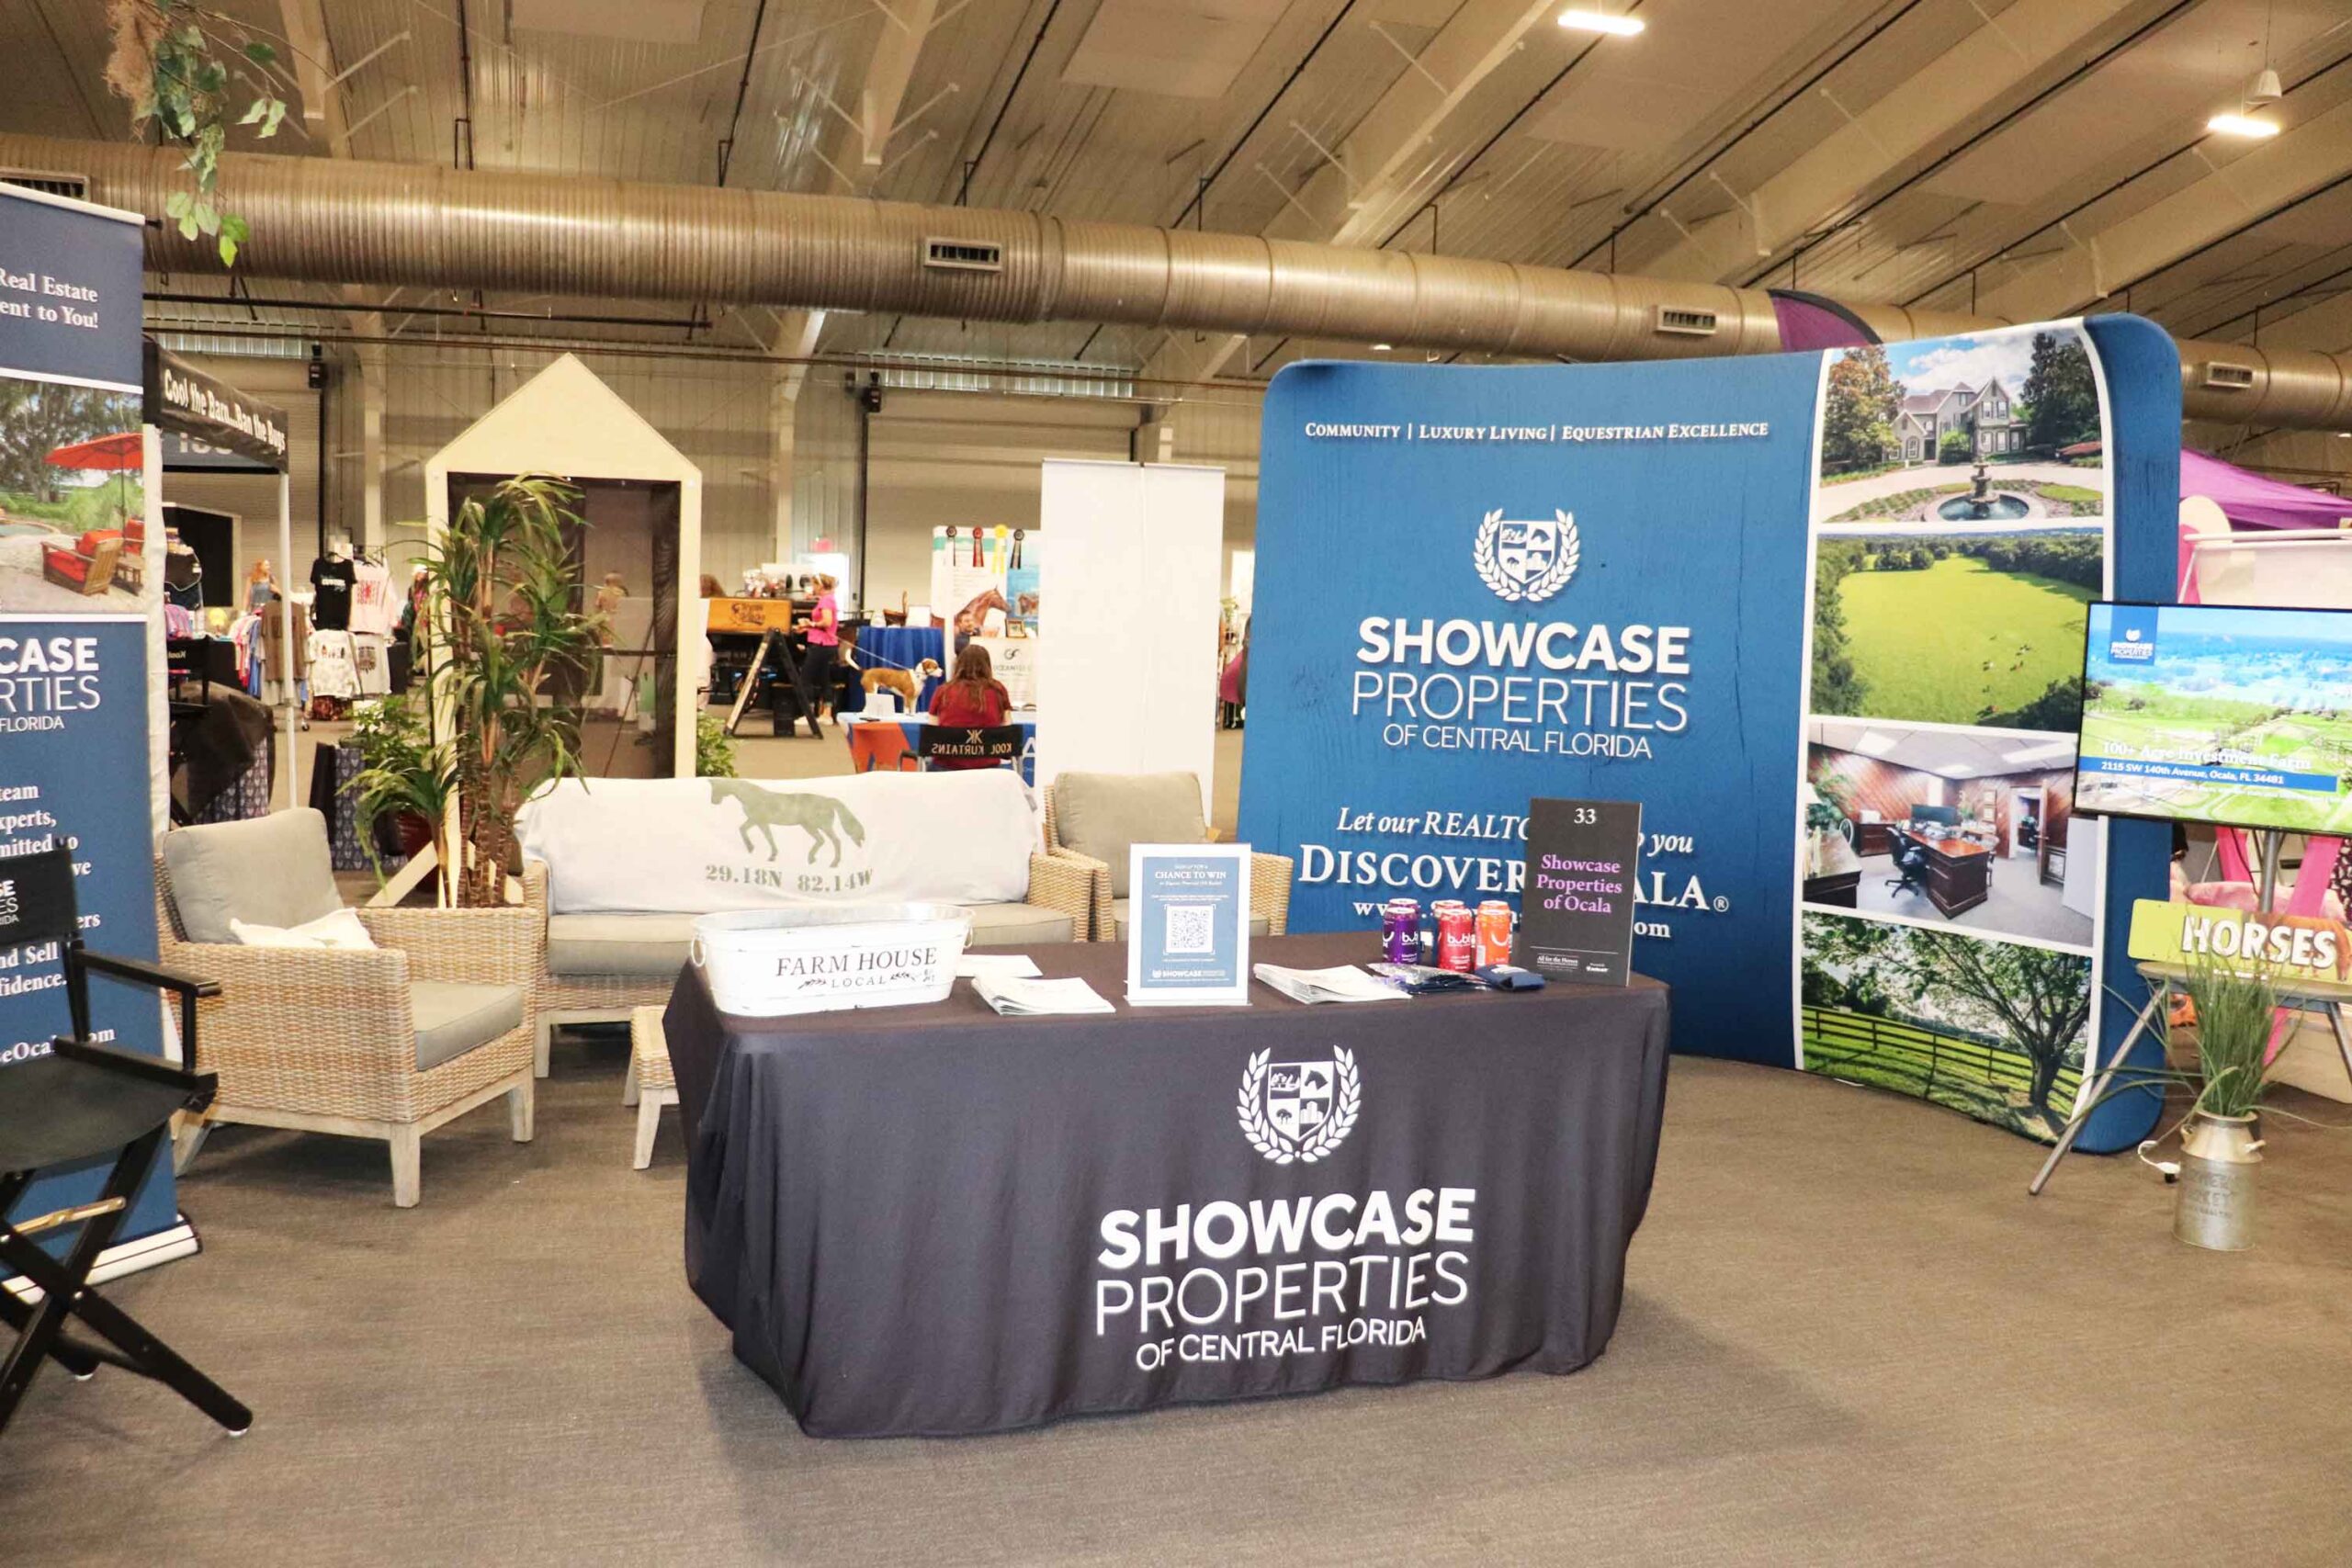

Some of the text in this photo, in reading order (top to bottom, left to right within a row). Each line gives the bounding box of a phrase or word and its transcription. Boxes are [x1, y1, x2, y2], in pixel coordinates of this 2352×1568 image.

[42, 276, 98, 302] Estate
[38, 306, 57, 321] to
[61, 306, 98, 328] You!
[1305, 423, 1400, 437] COMMUNITY
[1419, 424, 1486, 440] LUXURY
[1562, 425, 1664, 442] EQUESTRIAN
[1668, 423, 1769, 439] EXCELLENCE
[0, 637, 99, 674] CASE
[1356, 615, 1690, 675] SHOWCASE
[0, 675, 101, 713] RTIES
[1351, 671, 1689, 733] PROPERTIES
[1384, 723, 1653, 760] OF CENTRAL FLORIDA
[2101, 761, 2124, 772] 2115
[2125, 763, 2143, 773] SW
[2144, 764, 2170, 775] 140th
[2239, 773, 2251, 782] FL
[2253, 773, 2284, 784] 34481
[1573, 807, 1597, 825] 33
[1336, 807, 1374, 831] Let
[1378, 816, 1420, 834] our
[1646, 833, 1693, 857] you
[1155, 871, 1227, 879] CHANCE TO WIN
[1298, 844, 1527, 893] DISCOVER
[1541, 853, 1621, 874] Showcase
[706, 864, 873, 892] 29.18N 82.14W
[1536, 874, 1623, 895] Properties
[1544, 895, 1611, 913] of Ocala
[26, 941, 59, 964] Sell
[2182, 915, 2336, 968] HORSES
[775, 947, 937, 976] FARM HOUSE
[831, 976, 887, 988] LOCAL
[1098, 1187, 1476, 1269] SHOWCASE
[1097, 1251, 1468, 1336] PROPERTIES
[1136, 1316, 1426, 1371] OF CENTRAL FLORIDA
